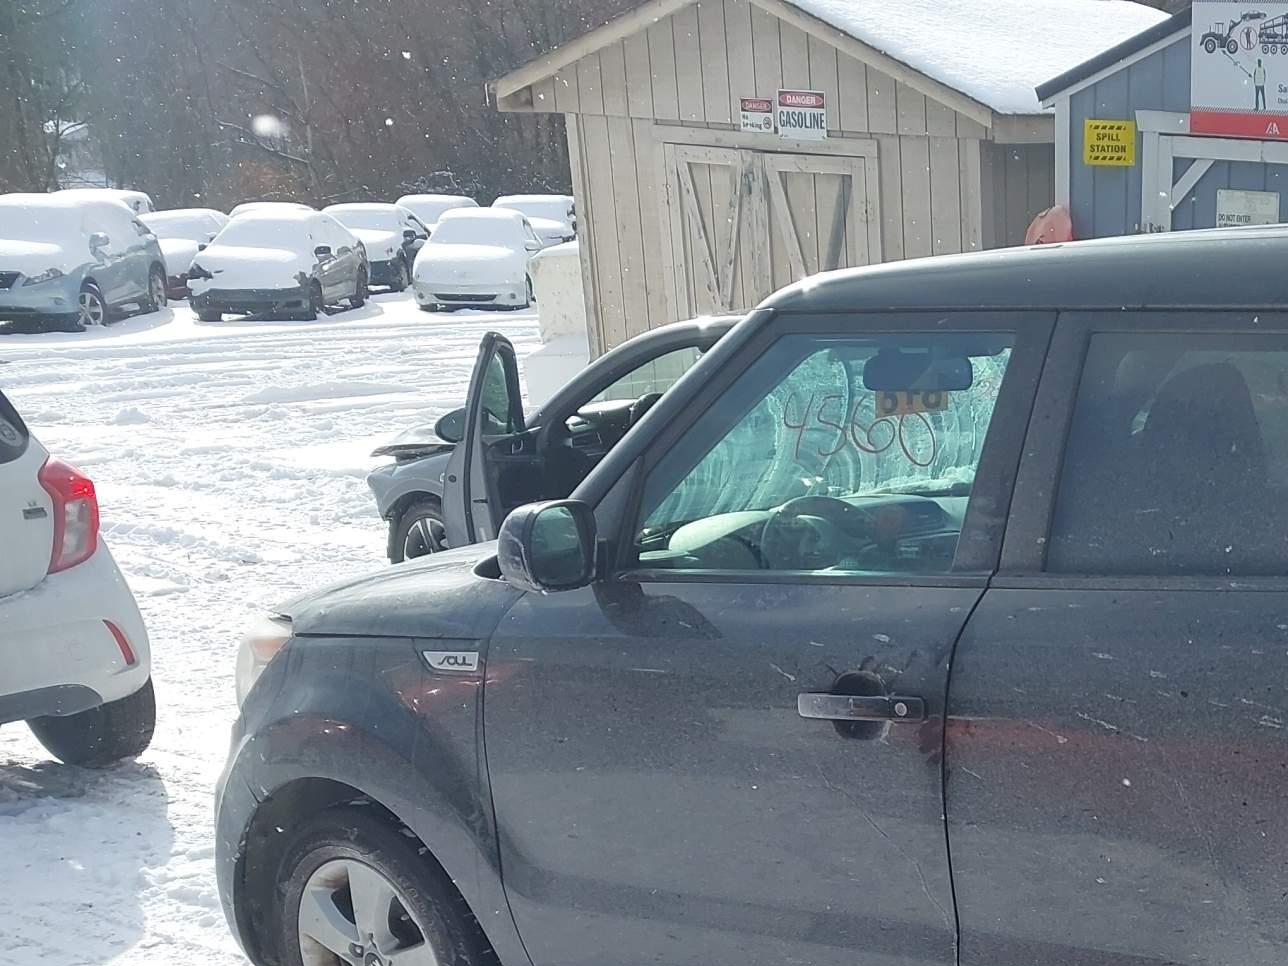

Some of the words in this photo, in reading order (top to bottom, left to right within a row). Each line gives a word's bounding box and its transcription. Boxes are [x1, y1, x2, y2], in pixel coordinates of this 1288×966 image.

[786, 95, 816, 105] DANGER
[745, 101, 768, 110] DANGER
[779, 110, 825, 130] GASOLINE
[1096, 132, 1120, 141] SPILL
[1090, 144, 1126, 153] STATION
[1218, 213, 1225, 221] DO
[1226, 214, 1235, 222] NOT
[1236, 215, 1251, 223] ENTER
